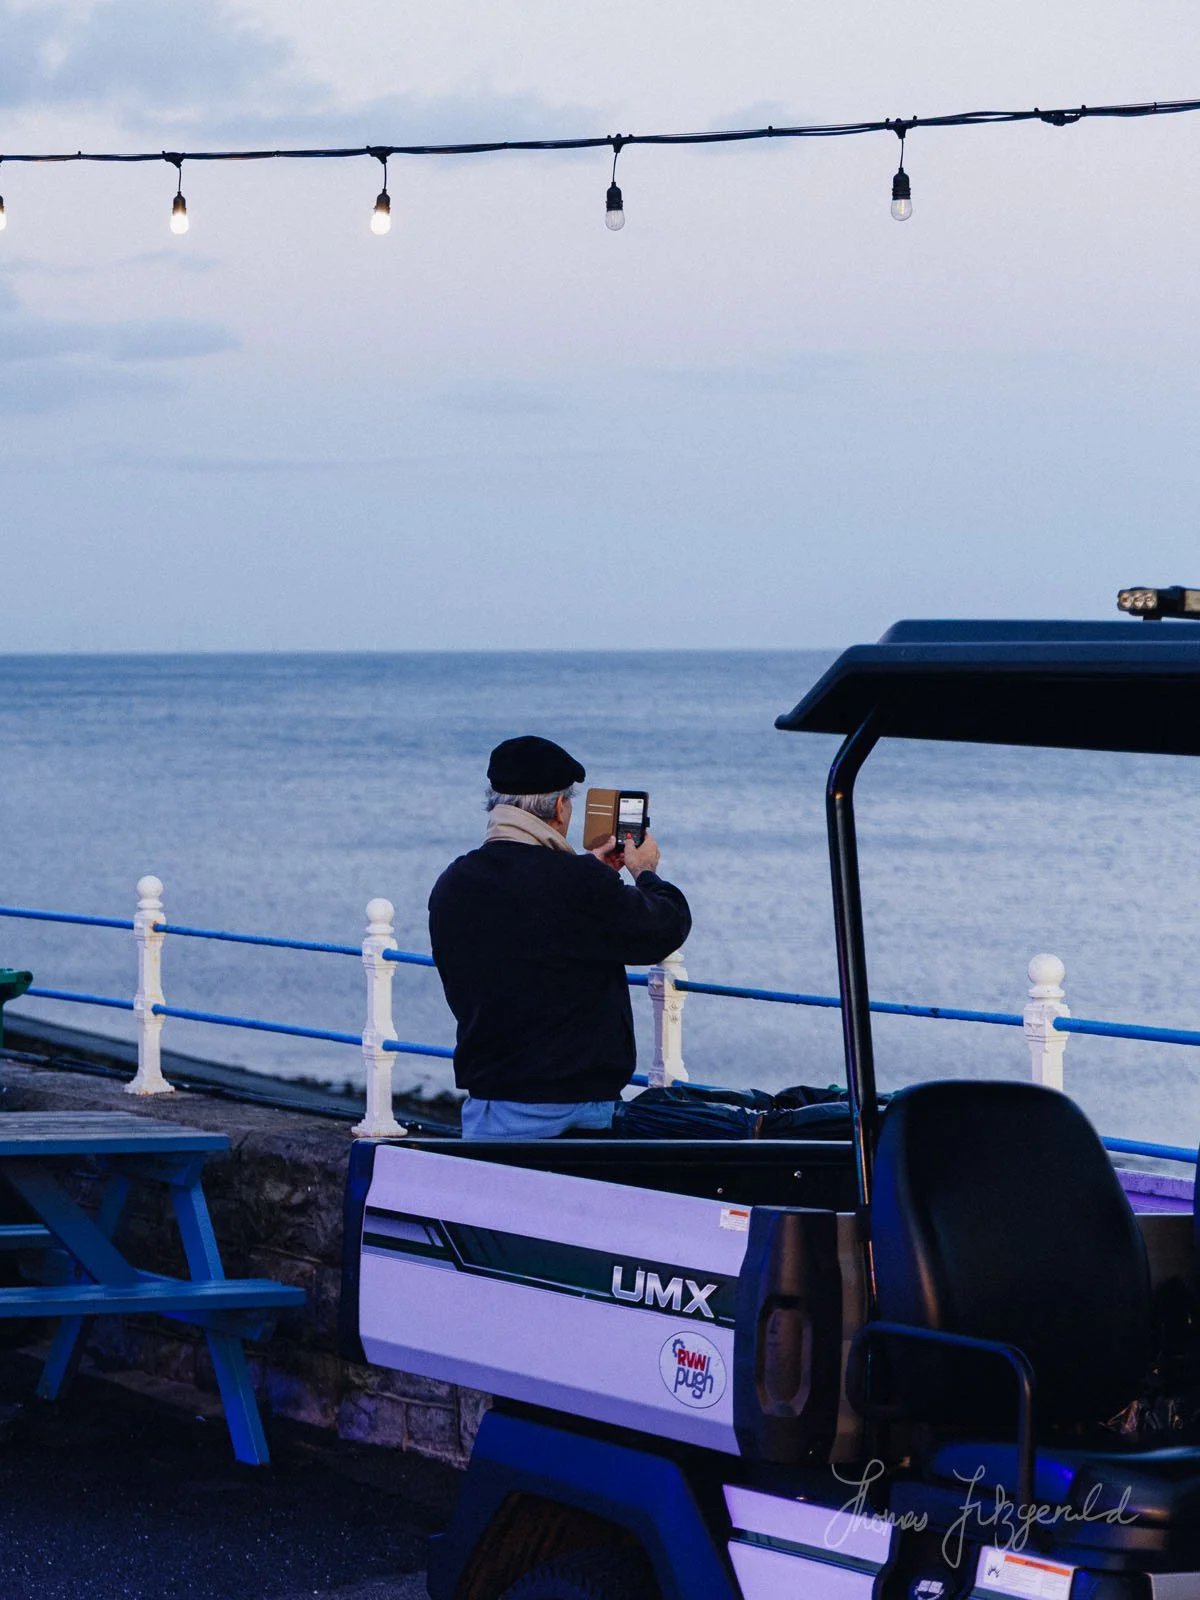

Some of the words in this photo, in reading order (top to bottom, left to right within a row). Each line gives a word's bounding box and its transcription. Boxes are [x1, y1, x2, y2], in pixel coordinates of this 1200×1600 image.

[612, 1266, 718, 1318] UMX
[673, 1356, 714, 1399] pugh
[677, 1348, 707, 1371] RVW
